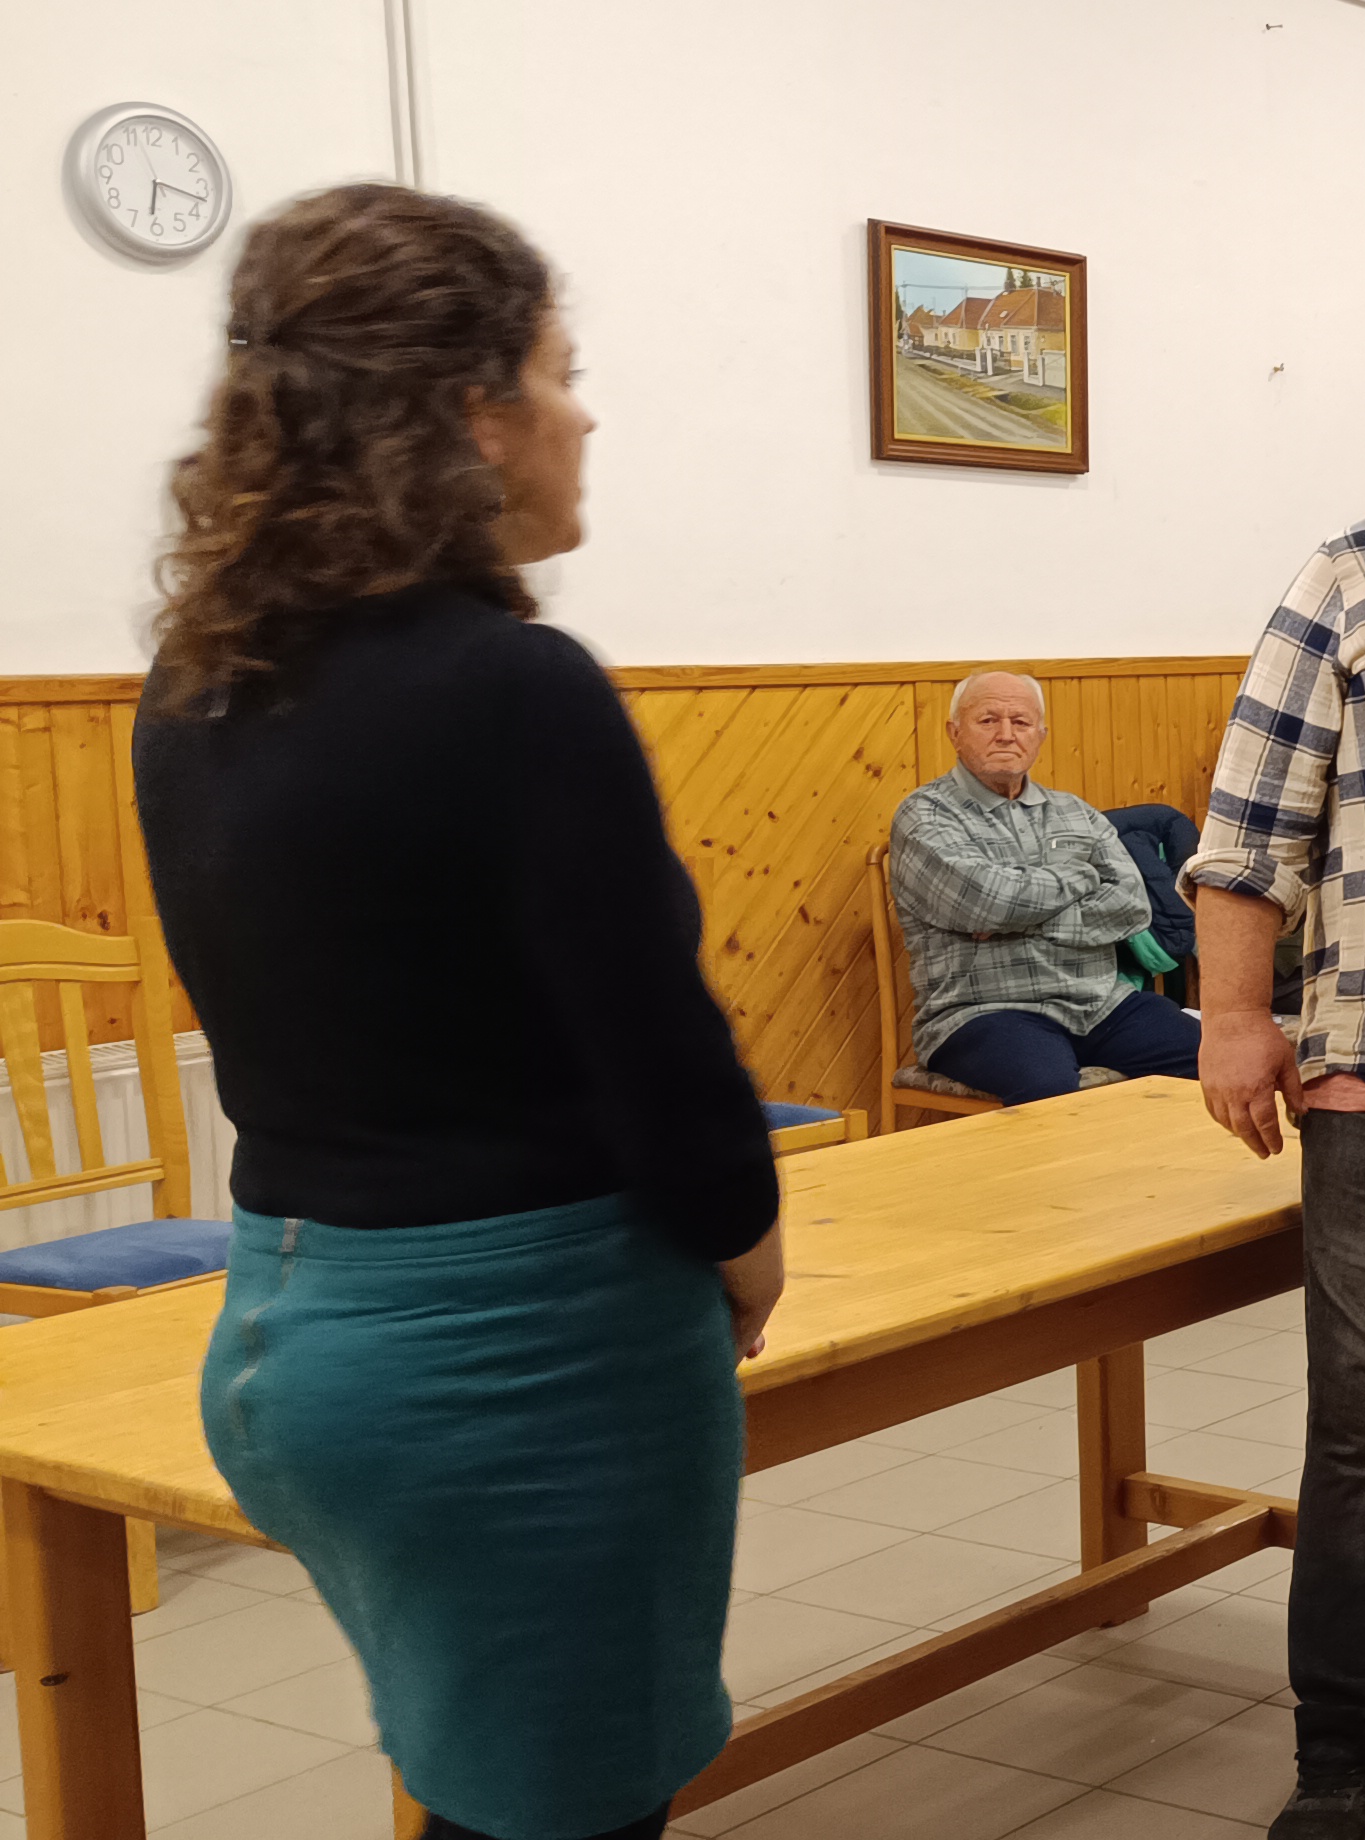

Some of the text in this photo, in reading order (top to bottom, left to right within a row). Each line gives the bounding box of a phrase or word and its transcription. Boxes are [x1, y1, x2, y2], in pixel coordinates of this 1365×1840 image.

[122, 126, 138, 147] 11
[142, 125, 163, 148] 12
[171, 136, 179, 156] 1
[101, 143, 125, 166] 10
[186, 152, 201, 173] 2
[99, 164, 113, 185] 9
[107, 187, 121, 209] 8
[195, 177, 209, 199] 3
[126, 208, 139, 228] 7
[187, 201, 201, 221] 4
[149, 216, 164, 237] 6
[172, 212, 187, 233] 5
